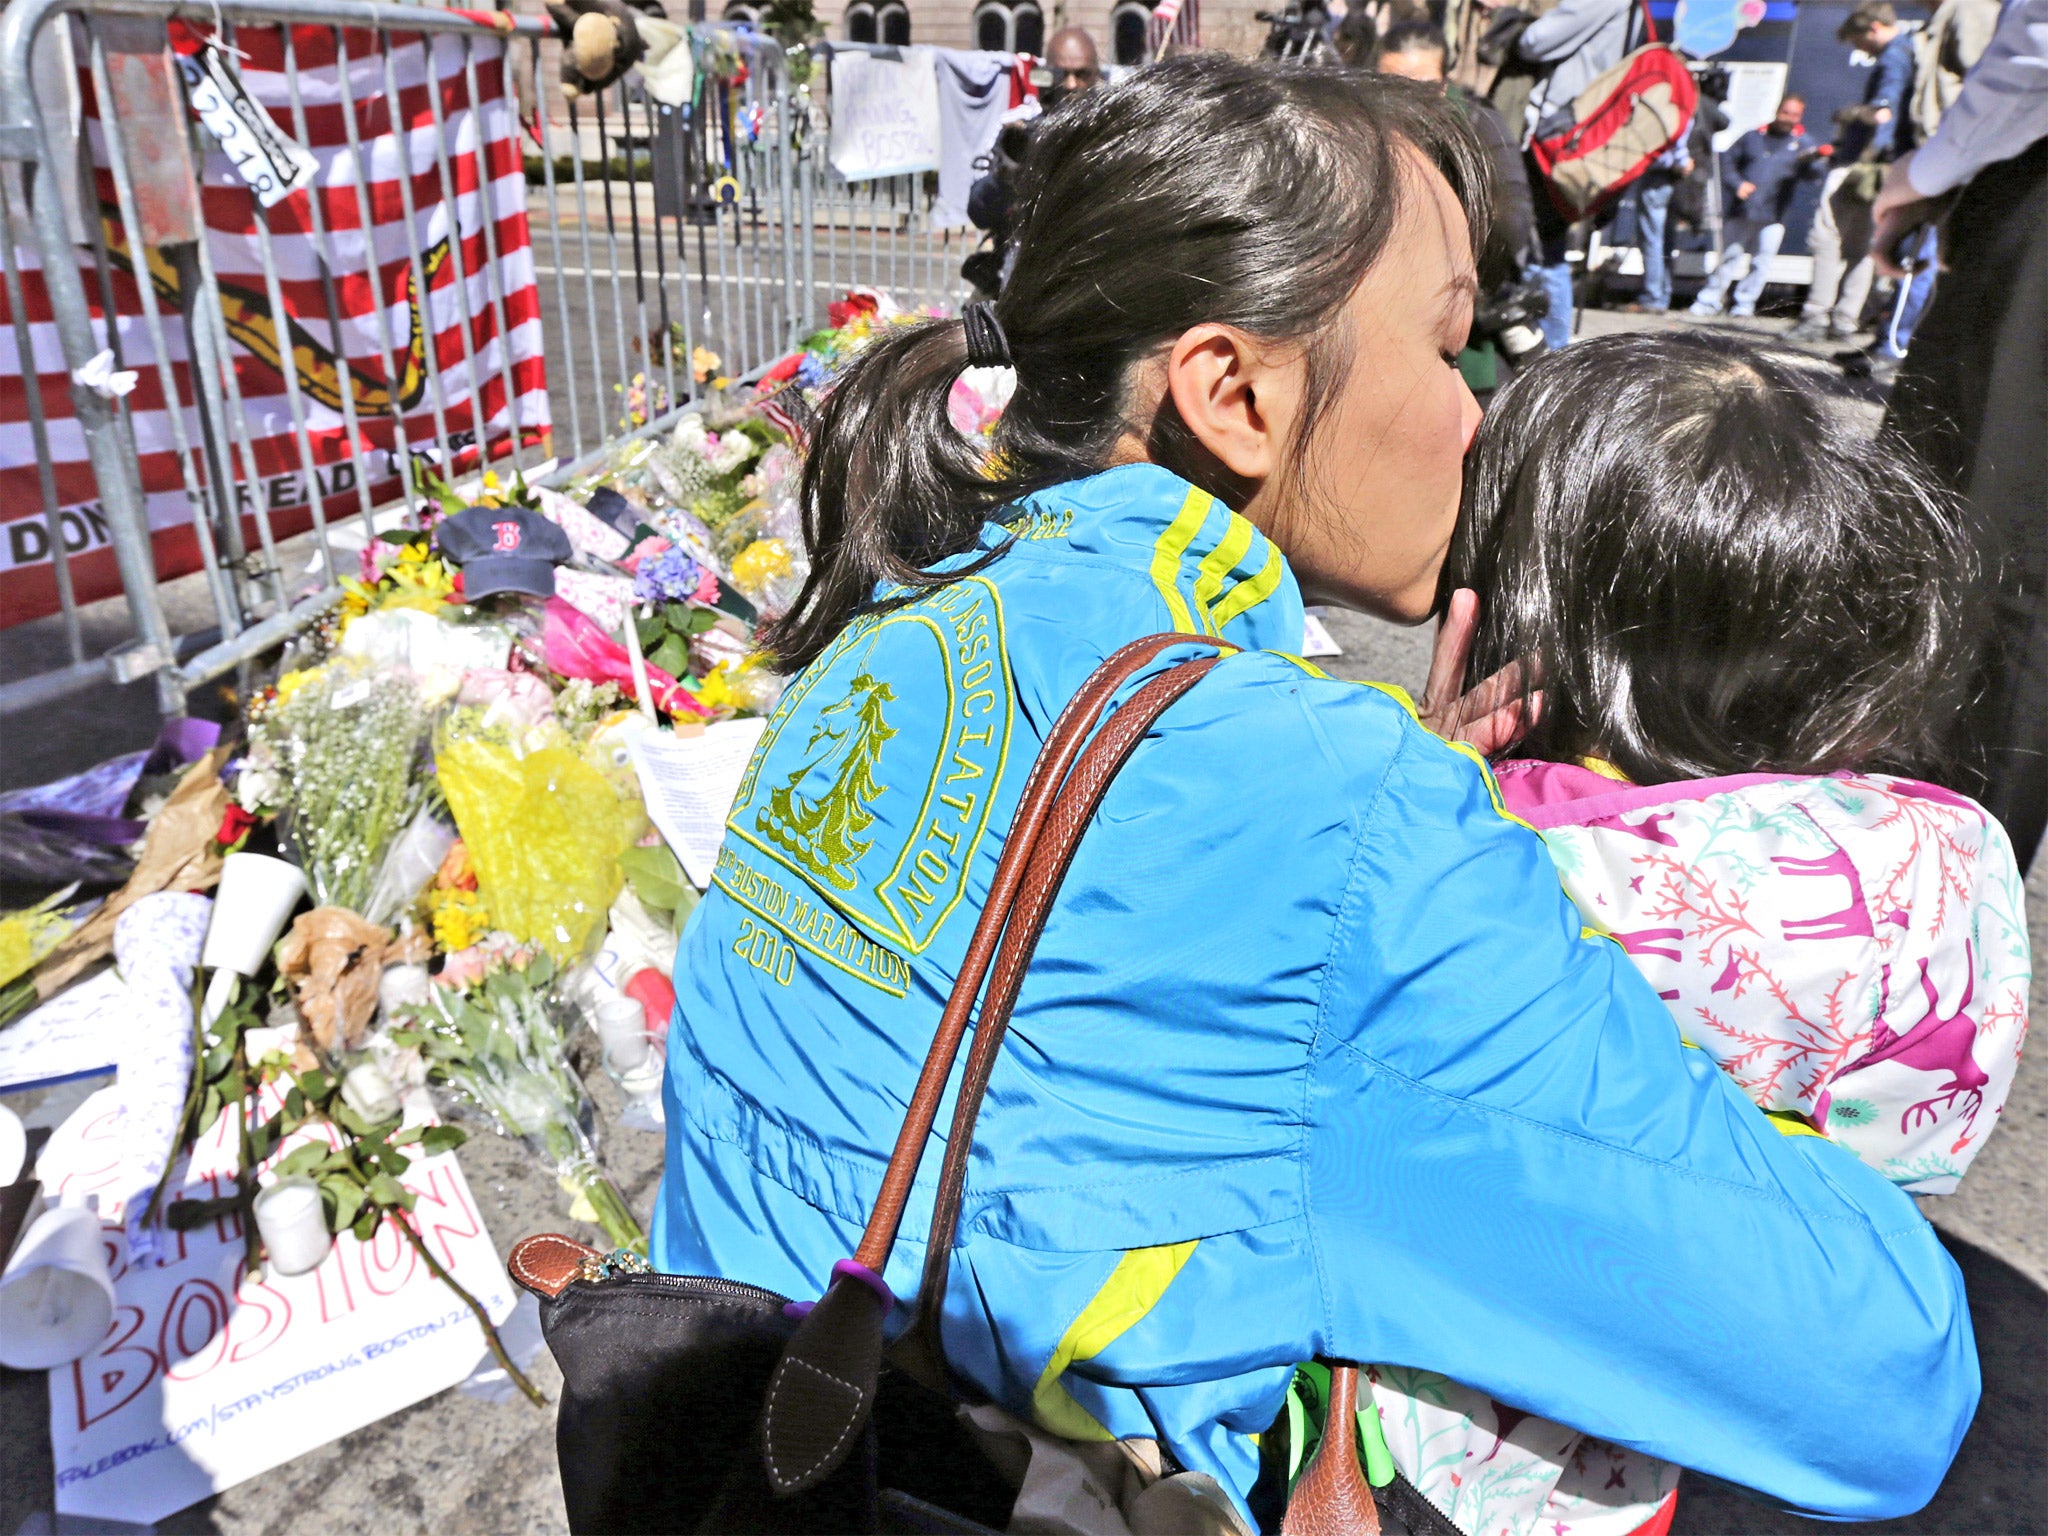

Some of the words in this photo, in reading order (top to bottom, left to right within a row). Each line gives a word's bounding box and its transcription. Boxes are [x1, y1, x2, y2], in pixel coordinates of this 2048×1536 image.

[491, 520, 522, 551] B
[897, 598, 997, 925] ASSOCIATION
[729, 859, 793, 920] BOSTON
[787, 895, 912, 990] MARATHON
[732, 917, 798, 987] 2010
